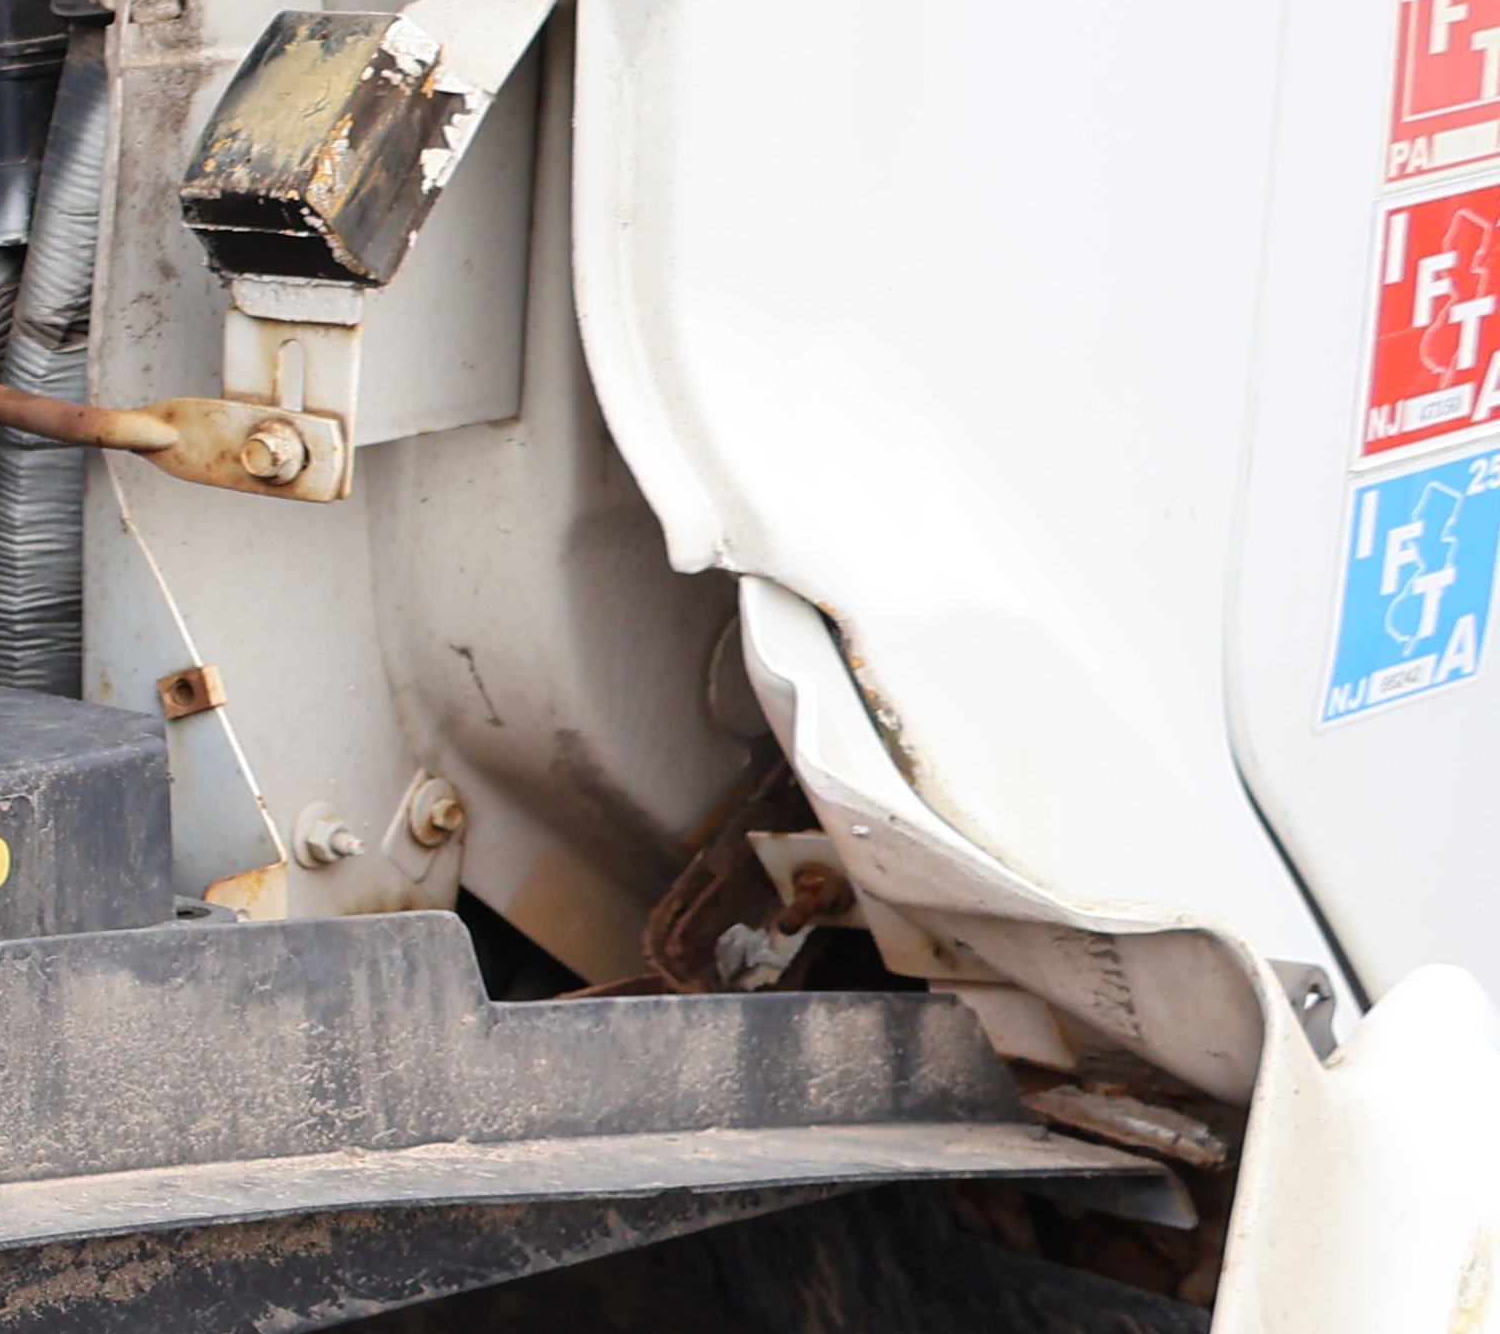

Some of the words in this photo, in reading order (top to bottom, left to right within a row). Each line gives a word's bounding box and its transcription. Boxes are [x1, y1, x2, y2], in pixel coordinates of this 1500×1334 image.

[1389, 134, 1431, 179] PA
[1366, 398, 1405, 443] NJ
[1327, 677, 1367, 718] NJ
